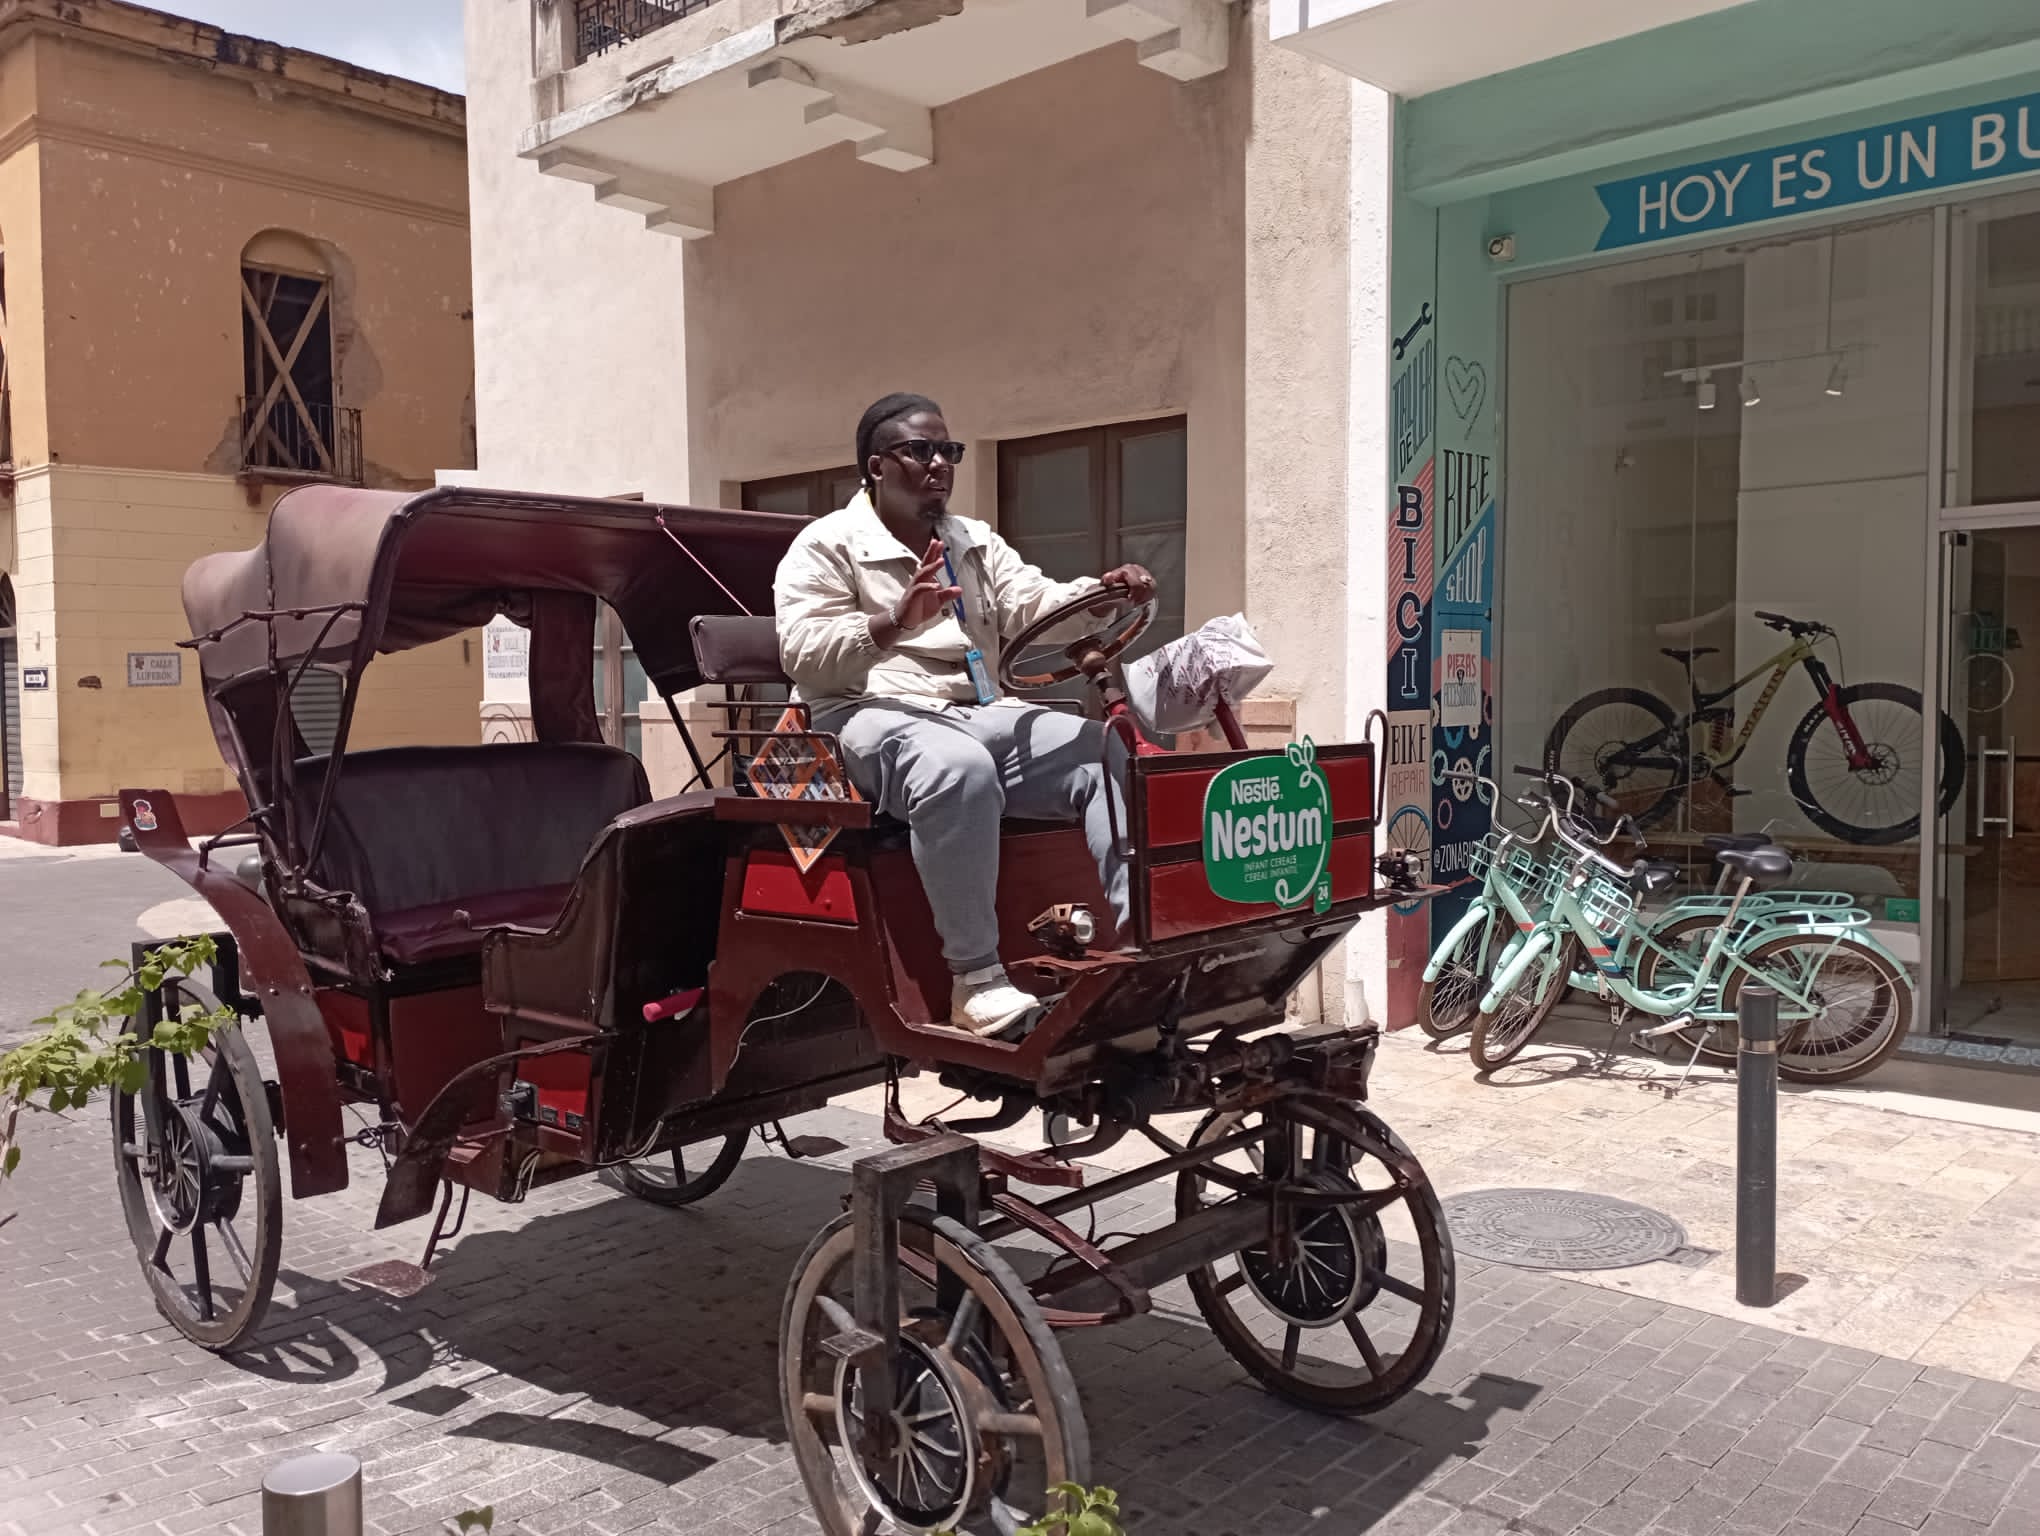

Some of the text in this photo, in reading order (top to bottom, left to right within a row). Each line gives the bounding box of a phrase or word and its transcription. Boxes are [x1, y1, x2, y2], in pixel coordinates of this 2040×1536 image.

[1637, 163, 1752, 234] HOY
[1772, 149, 1832, 208] ES
[1858, 125, 1936, 190] UN
[1392, 338, 1432, 483] TALLER
[1400, 431, 1412, 474] DE
[1441, 448, 1491, 568] BIKE
[1395, 485, 1424, 698] BICI
[1446, 526, 1487, 604] SHOP
[1390, 724, 1427, 765] BIKE
[1391, 769, 1426, 800] REPAIR
[1211, 804, 1322, 861] Nestum
